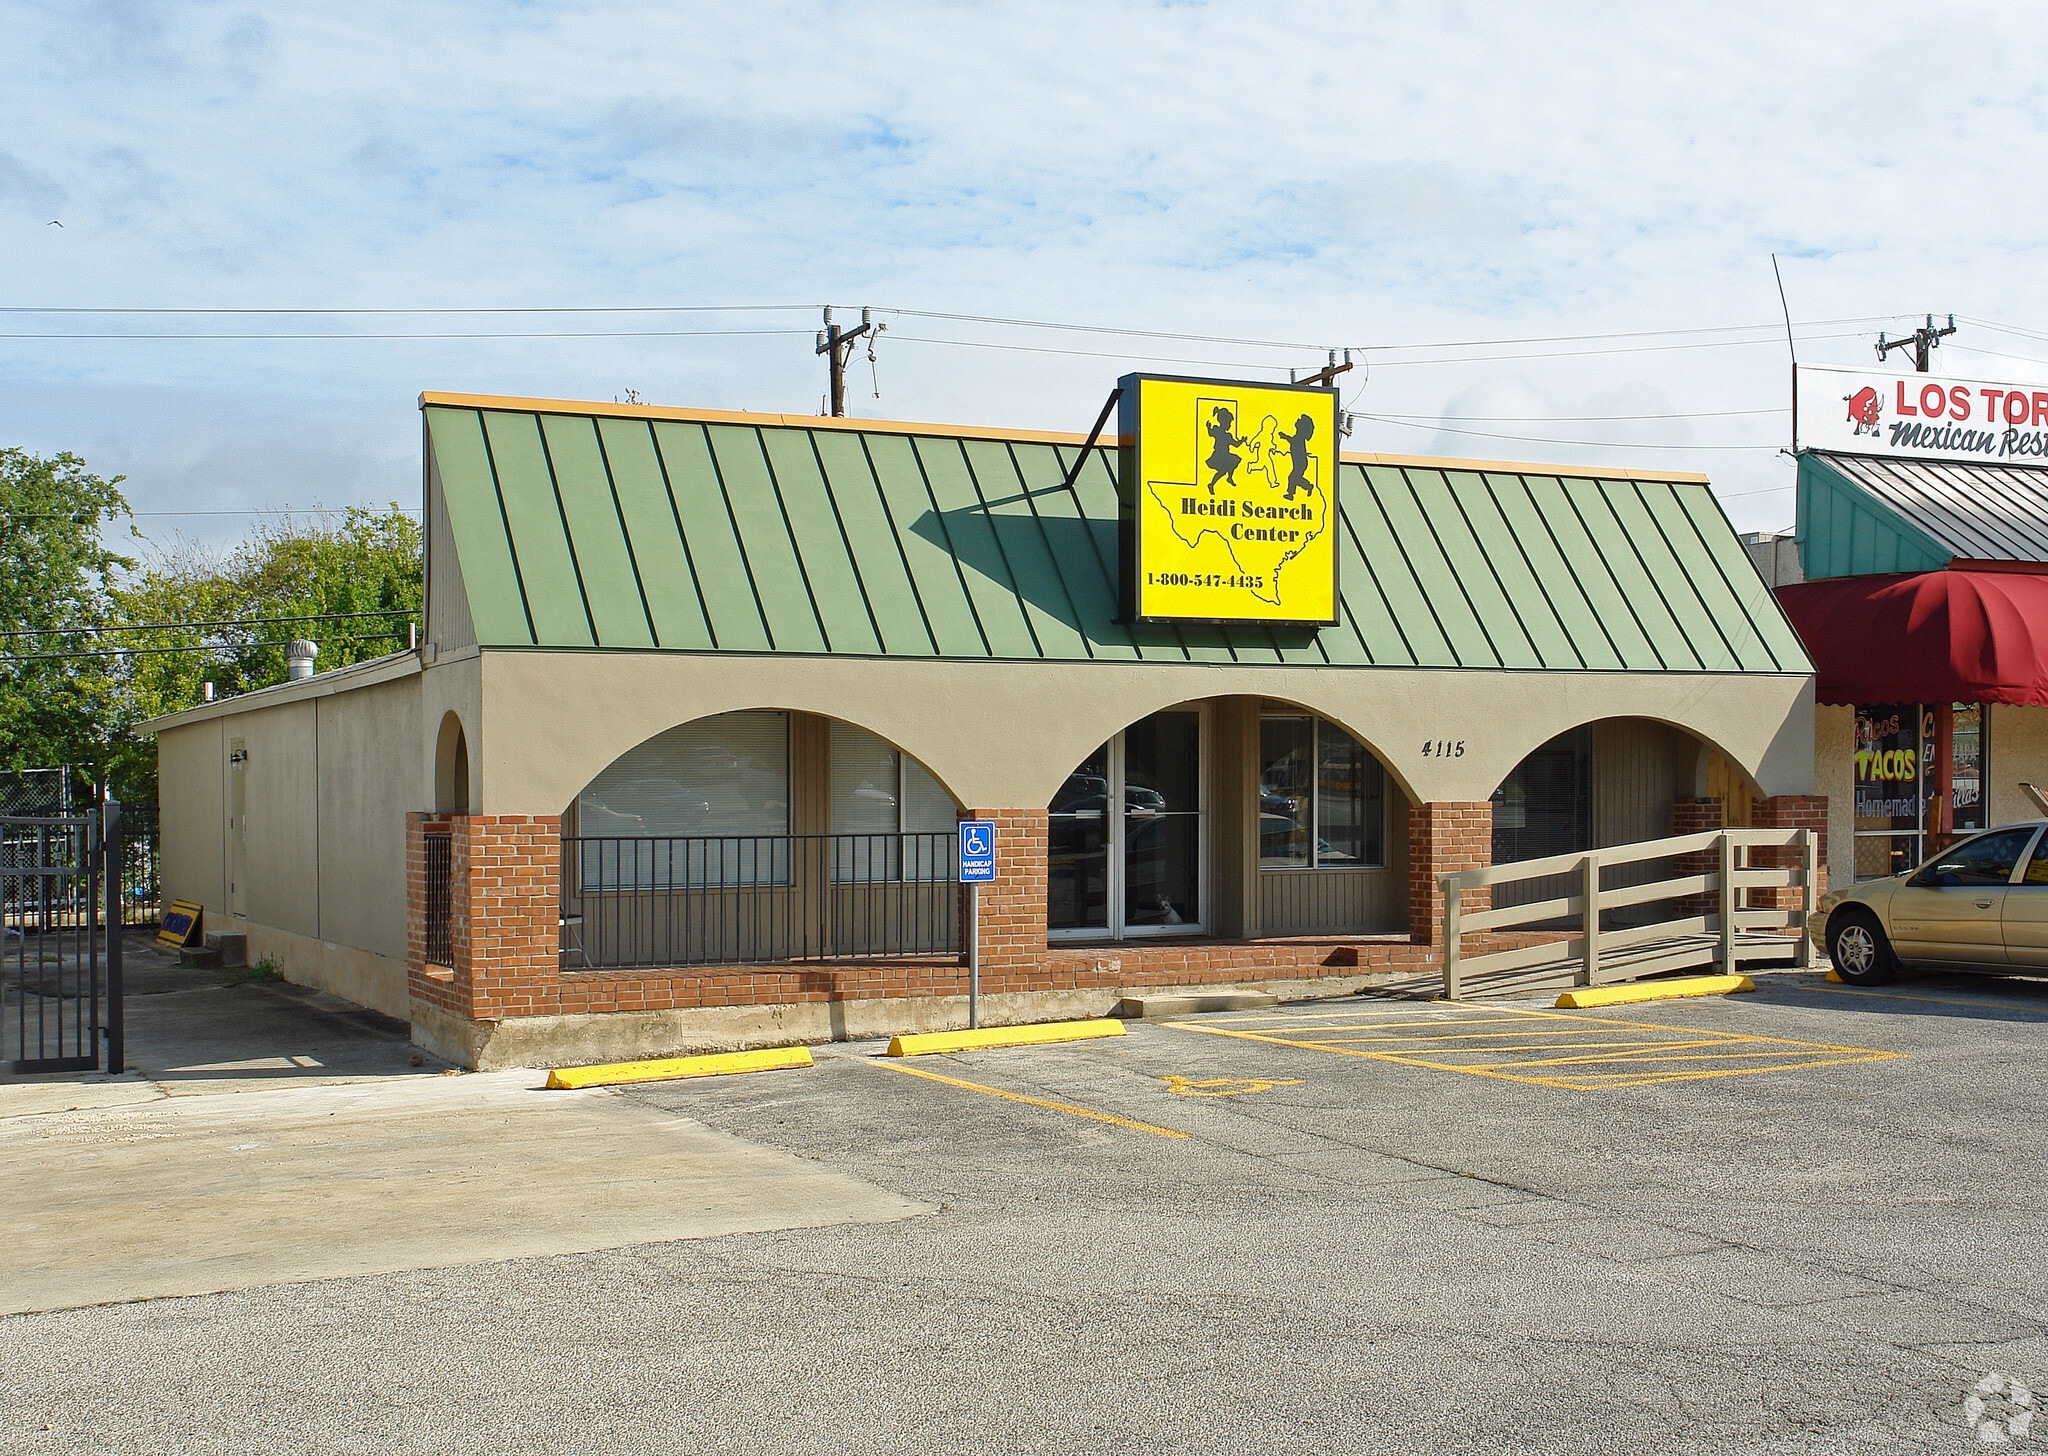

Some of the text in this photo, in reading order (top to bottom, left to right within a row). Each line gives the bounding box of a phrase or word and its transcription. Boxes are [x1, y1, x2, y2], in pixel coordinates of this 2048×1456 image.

[1897, 381, 2048, 426] LOS TOR
[1889, 421, 1996, 454] Mexican
[1181, 498, 1313, 521] Heidi Search
[1231, 523, 1300, 542] Center
[1147, 572, 1264, 589] 1-800-547-4435
[1854, 715, 1899, 749] Ricos
[1421, 740, 1465, 757] 4115
[1854, 748, 1916, 782] TACOS
[1856, 790, 1927, 818] Homemade
